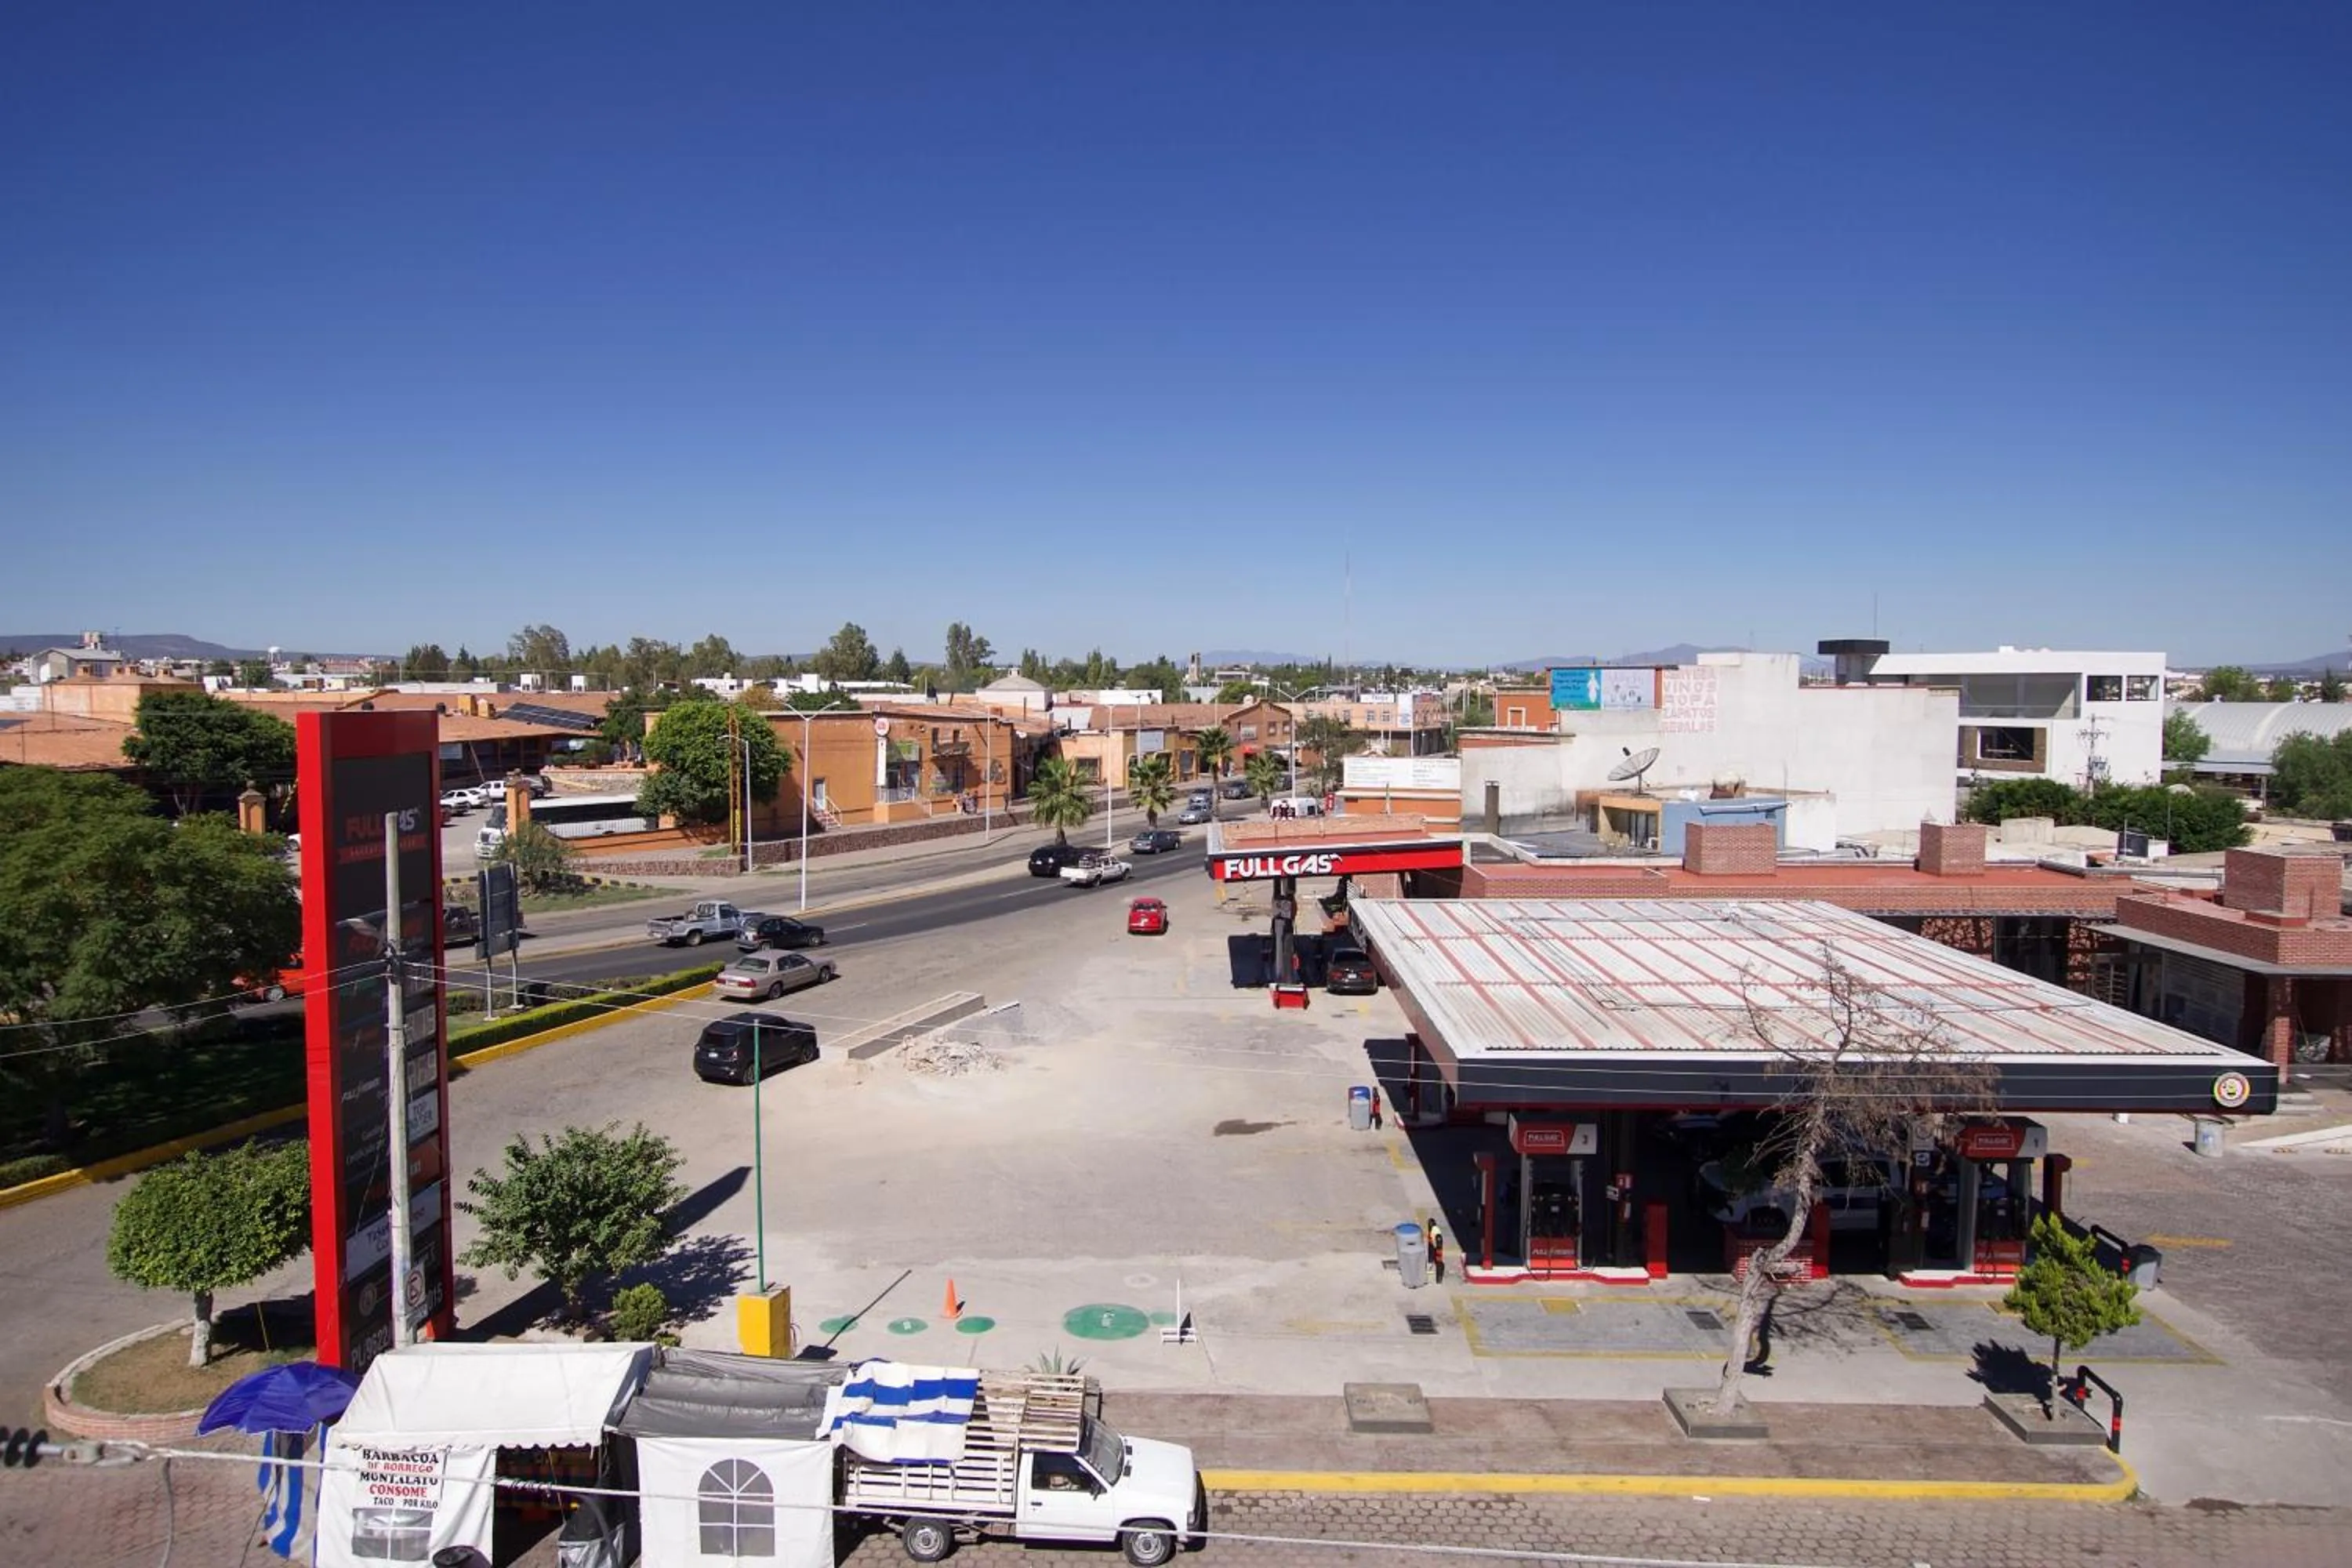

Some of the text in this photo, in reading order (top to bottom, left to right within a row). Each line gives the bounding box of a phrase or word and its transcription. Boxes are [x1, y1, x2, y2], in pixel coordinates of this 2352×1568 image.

[1664, 681, 1716, 692] VINOS
[363, 1448, 439, 1464] BARBACOA
[384, 1462, 434, 1473] BORREGO
[369, 1483, 427, 1497] CONSOME
[373, 1497, 394, 1505] TACO
